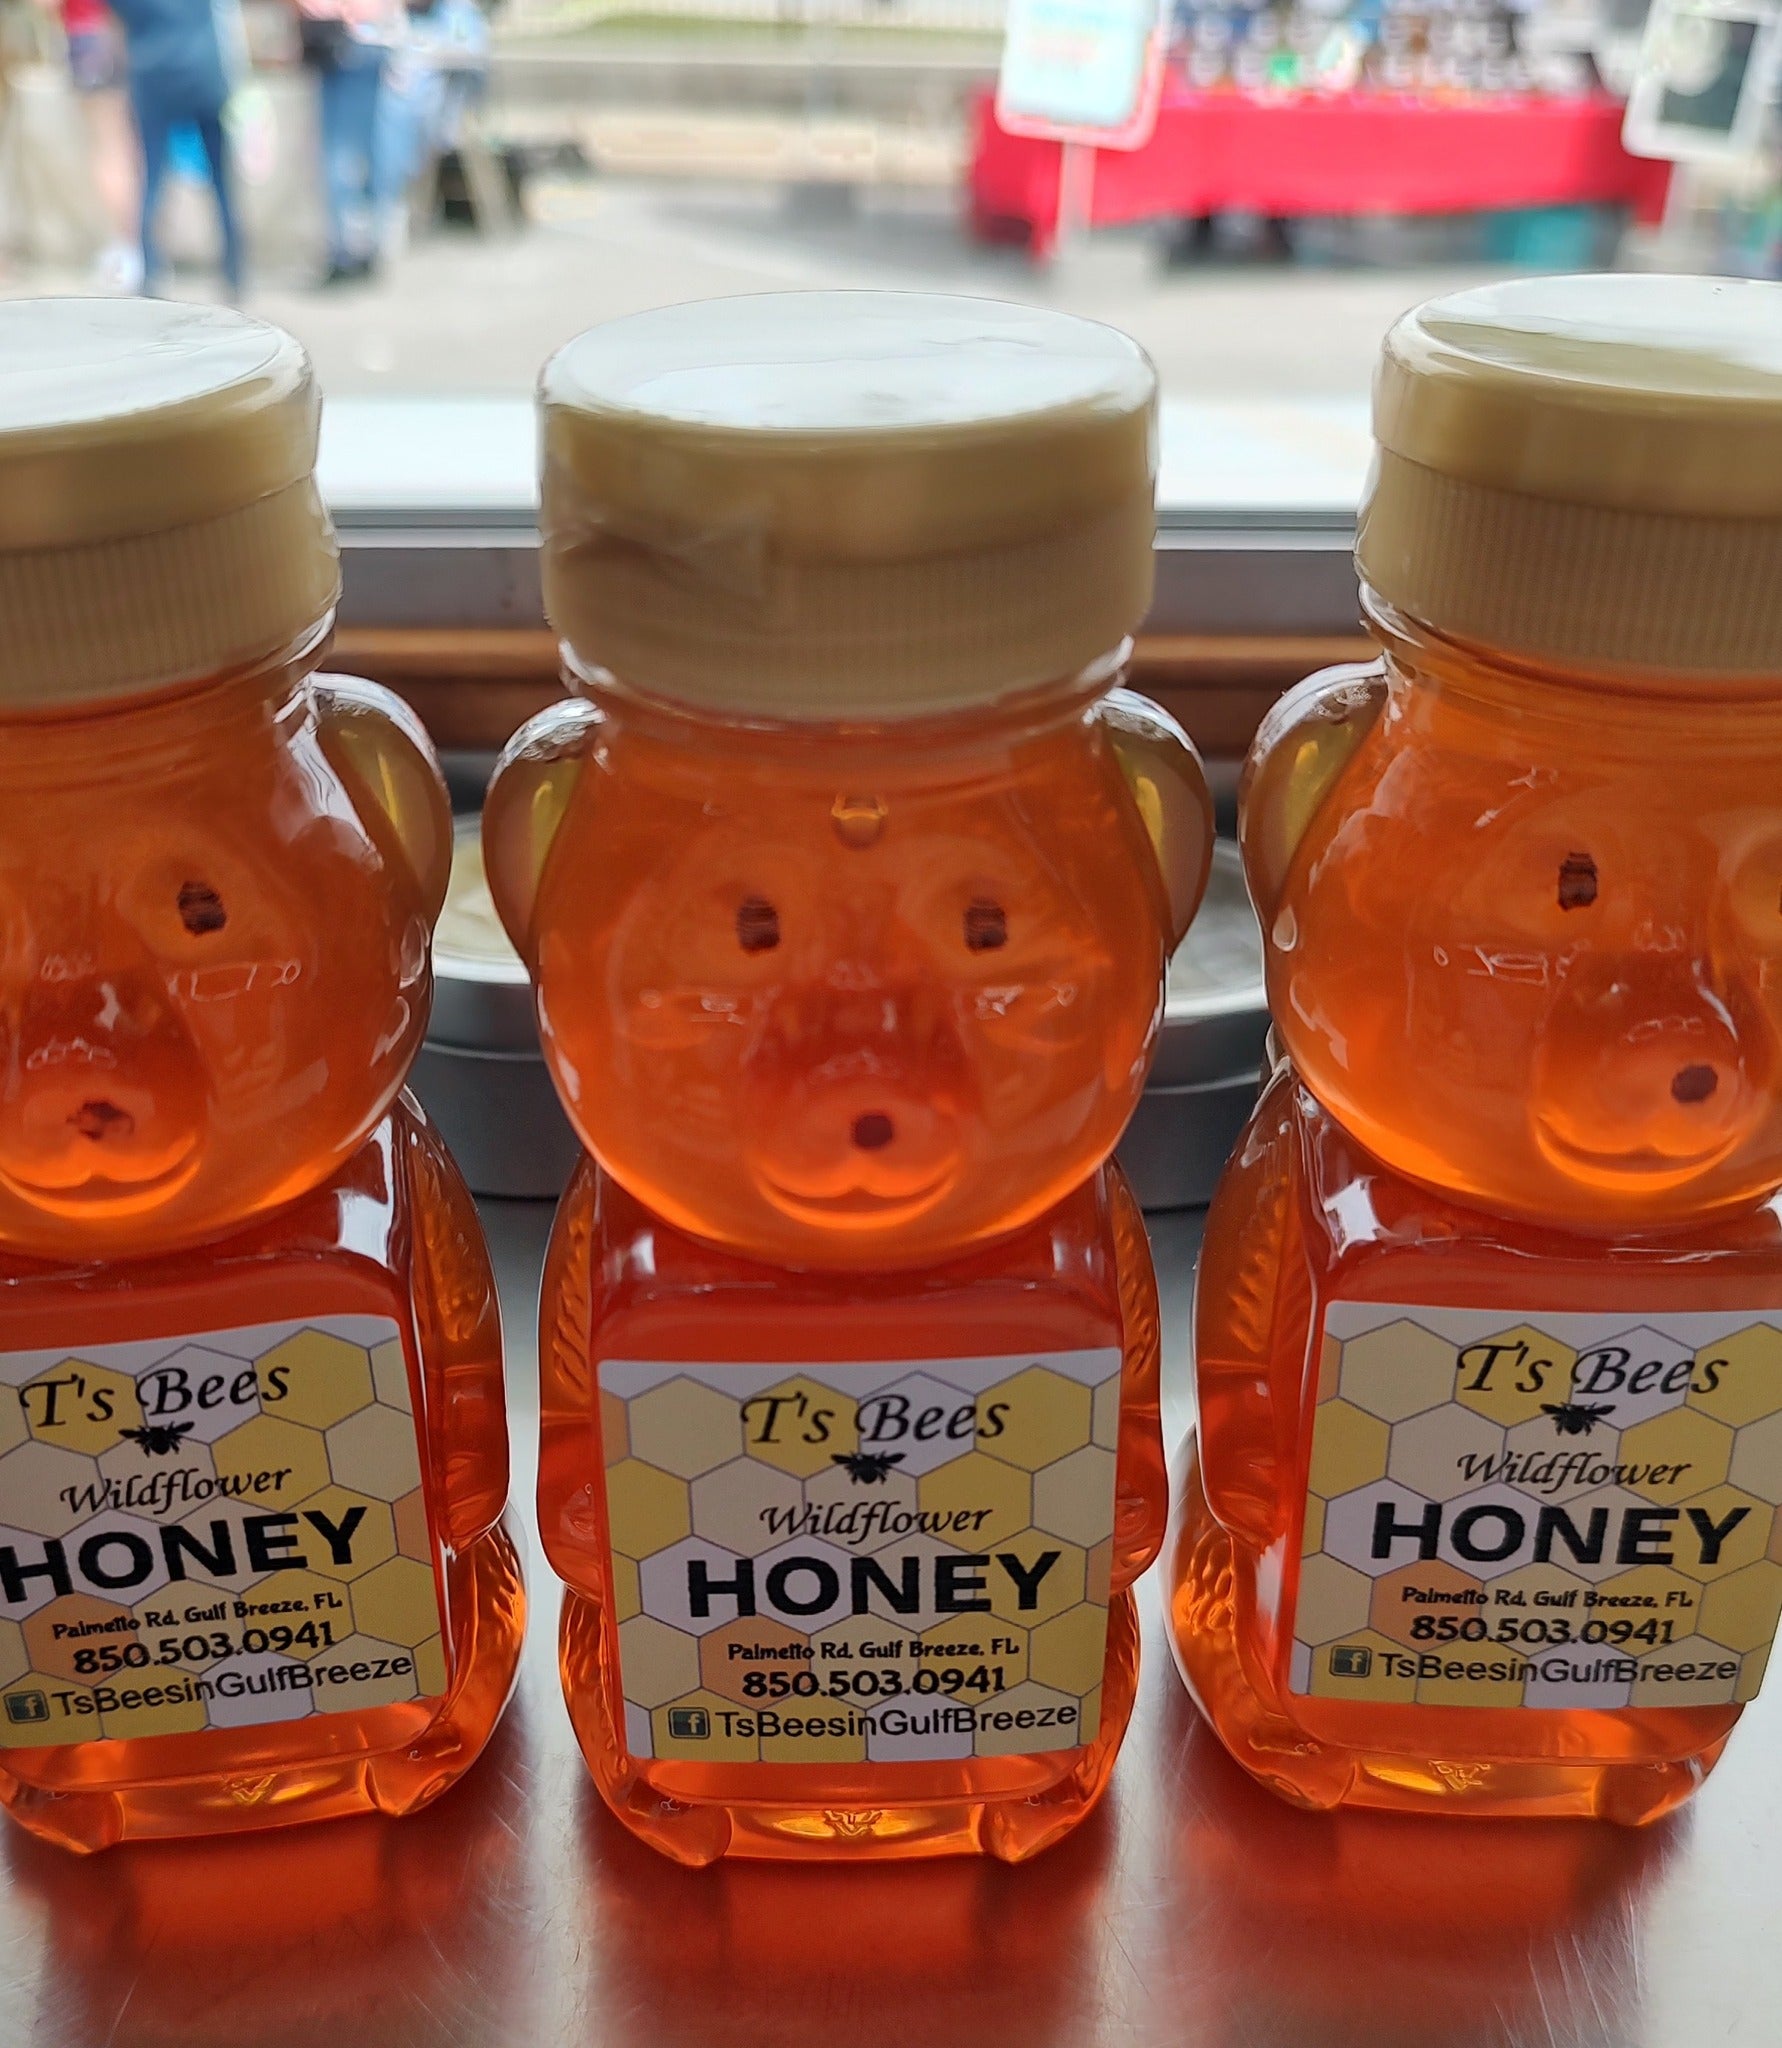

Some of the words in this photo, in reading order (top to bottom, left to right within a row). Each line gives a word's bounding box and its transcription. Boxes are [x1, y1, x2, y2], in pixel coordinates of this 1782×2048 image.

[1457, 1341, 1552, 1391] T's
[1571, 1347, 1728, 1394] Bees
[20, 1373, 115, 1428] T's
[135, 1365, 291, 1415] Bees
[741, 1391, 835, 1444] T's
[855, 1394, 1010, 1441] Bees
[60, 1466, 292, 1514] Wildflower
[1457, 1451, 1692, 1493] Wildflower
[759, 1501, 993, 1544] Wildflower
[1371, 1503, 1751, 1564] HONEY
[0, 1507, 368, 1603] HONEY
[687, 1552, 1061, 1617] HONEY
[1402, 1586, 1488, 1605] Palmetto
[1533, 1590, 1577, 1607] Gulf
[1665, 1592, 1692, 1607] FL
[53, 1616, 140, 1639] Palmetto
[185, 1603, 228, 1623] Gulf
[315, 1593, 342, 1610] FL
[1410, 1615, 1674, 1645] 850.503.0941
[74, 1621, 334, 1675] 850.503.0941
[728, 1642, 815, 1661] Palmetto
[859, 1640, 903, 1659] Gulf
[991, 1639, 1018, 1655] FL
[1379, 1652, 1737, 1682] TsBeesinGulfBreeze
[52, 1655, 413, 1717] TsBeesinGulfBreeze
[742, 1668, 1005, 1697] 850.503.0941
[716, 1705, 1077, 1738] TsBeesinGulfBreeze
